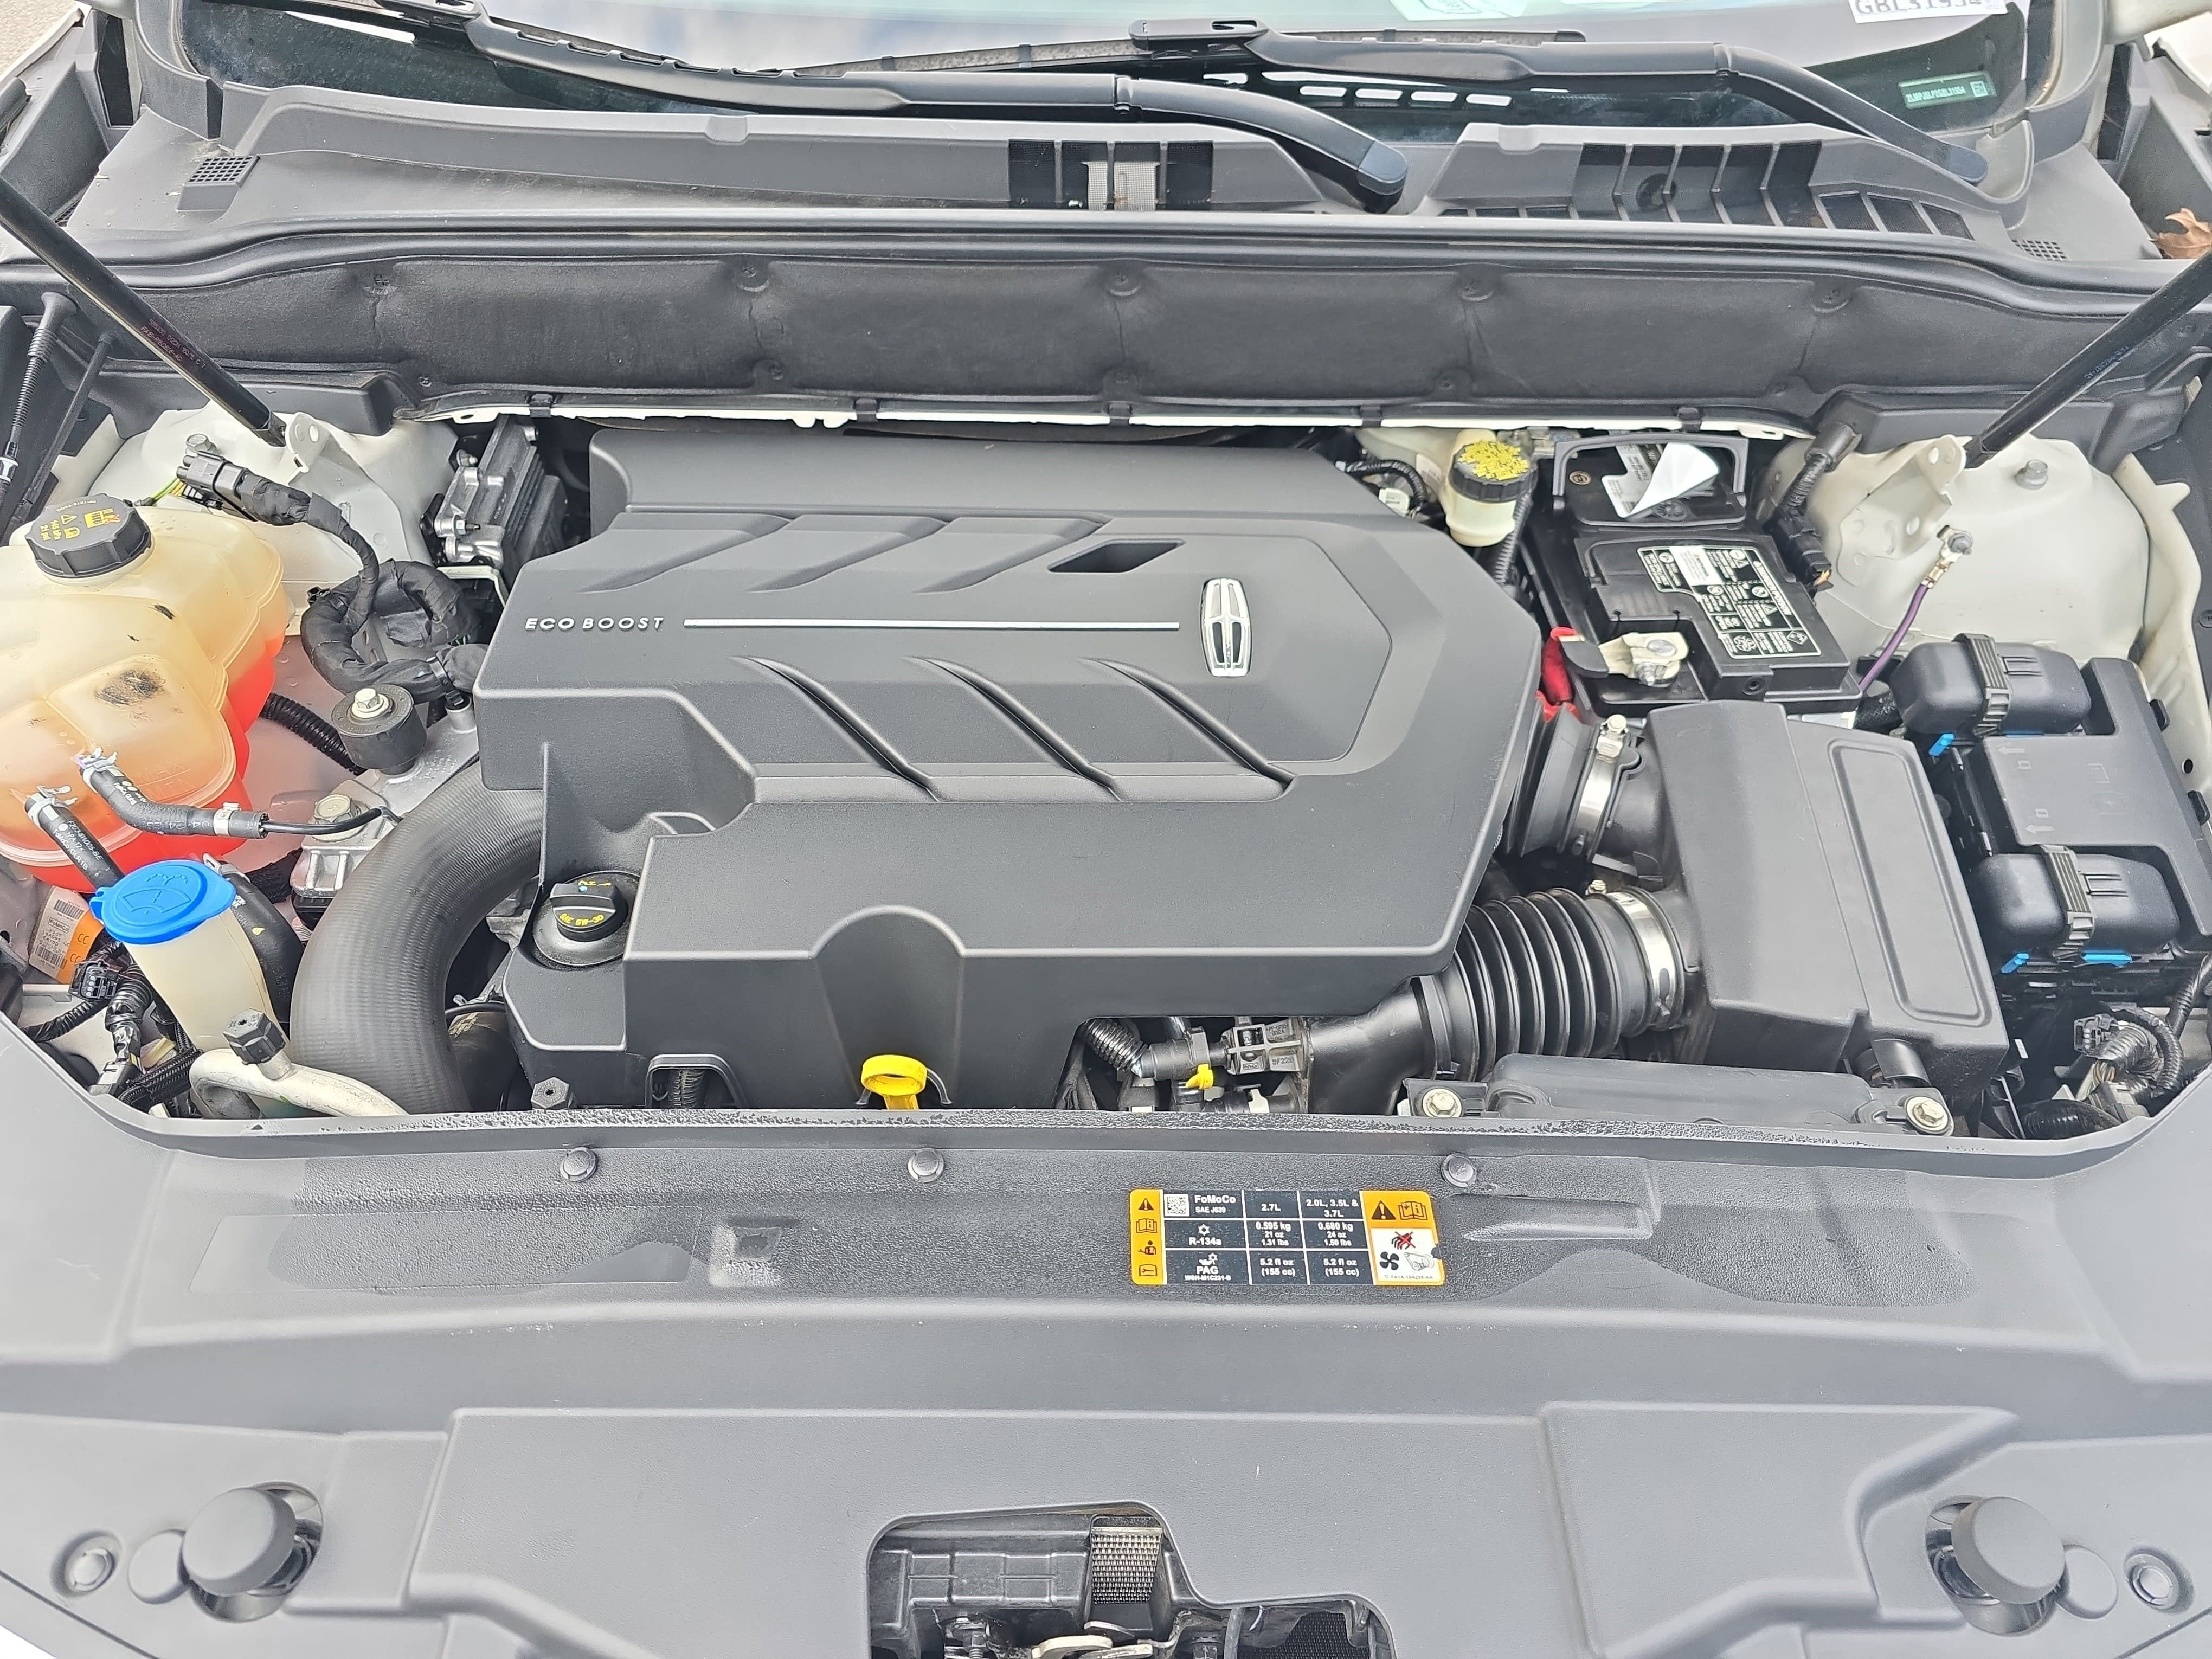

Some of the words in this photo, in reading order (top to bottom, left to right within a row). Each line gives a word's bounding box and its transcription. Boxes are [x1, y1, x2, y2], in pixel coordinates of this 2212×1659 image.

[525, 617, 575, 630] ECO
[582, 617, 664, 630] BOOST
[559, 913, 574, 924] SAE
[78, 933, 90, 945] CC
[1194, 1194, 1236, 1203] FoMoCo
[1306, 1199, 1328, 1208] 2.0L,
[1330, 1199, 1349, 1207] 3.5L
[1351, 1199, 1359, 1207] &
[1256, 1221, 1278, 1230] 0.595
[1279, 1221, 1291, 1232] kg
[1317, 1222, 1340, 1230] 0.680
[1342, 1222, 1353, 1232] kg
[1188, 1237, 1222, 1245] R-134a
[1196, 1266, 1219, 1275] PAG
[1261, 1268, 1281, 1277] (155
[1282, 1268, 1296, 1277] cc)
[1325, 1268, 1344, 1277] (155
[1346, 1268, 1360, 1277] cc)
